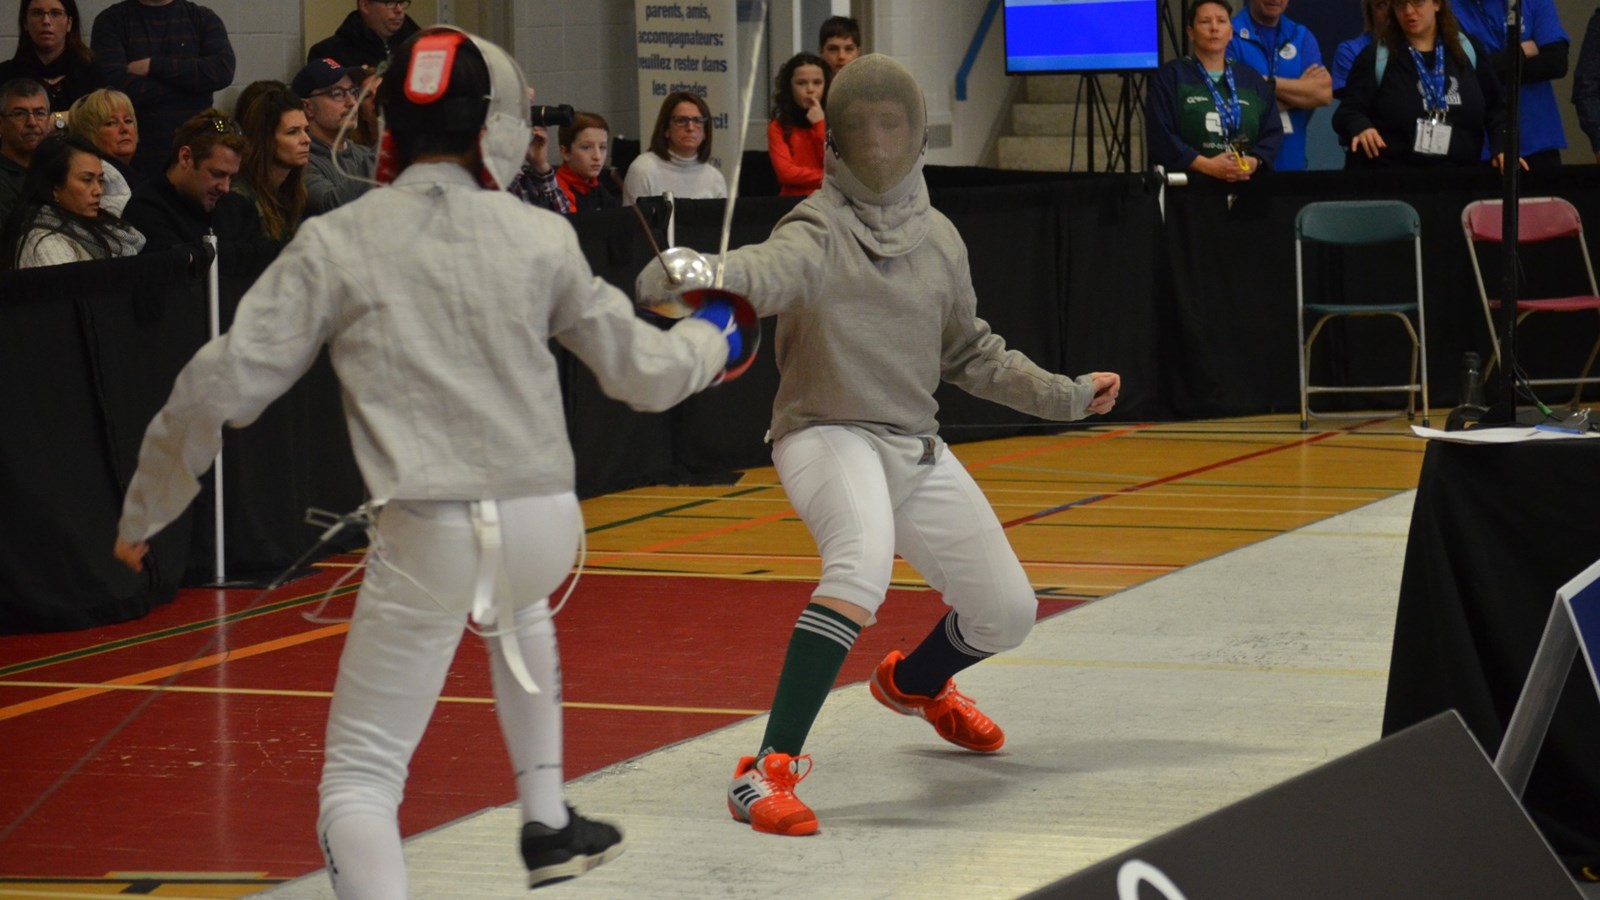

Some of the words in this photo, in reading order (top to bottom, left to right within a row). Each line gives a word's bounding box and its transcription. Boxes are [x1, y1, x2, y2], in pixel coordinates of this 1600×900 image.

[646, 3, 684, 21] parents,
[686, 3, 711, 23] amis,
[638, 54, 671, 70] euillez
[674, 56, 699, 71] rester
[702, 56, 728, 73] dans
[652, 80, 667, 96] les
